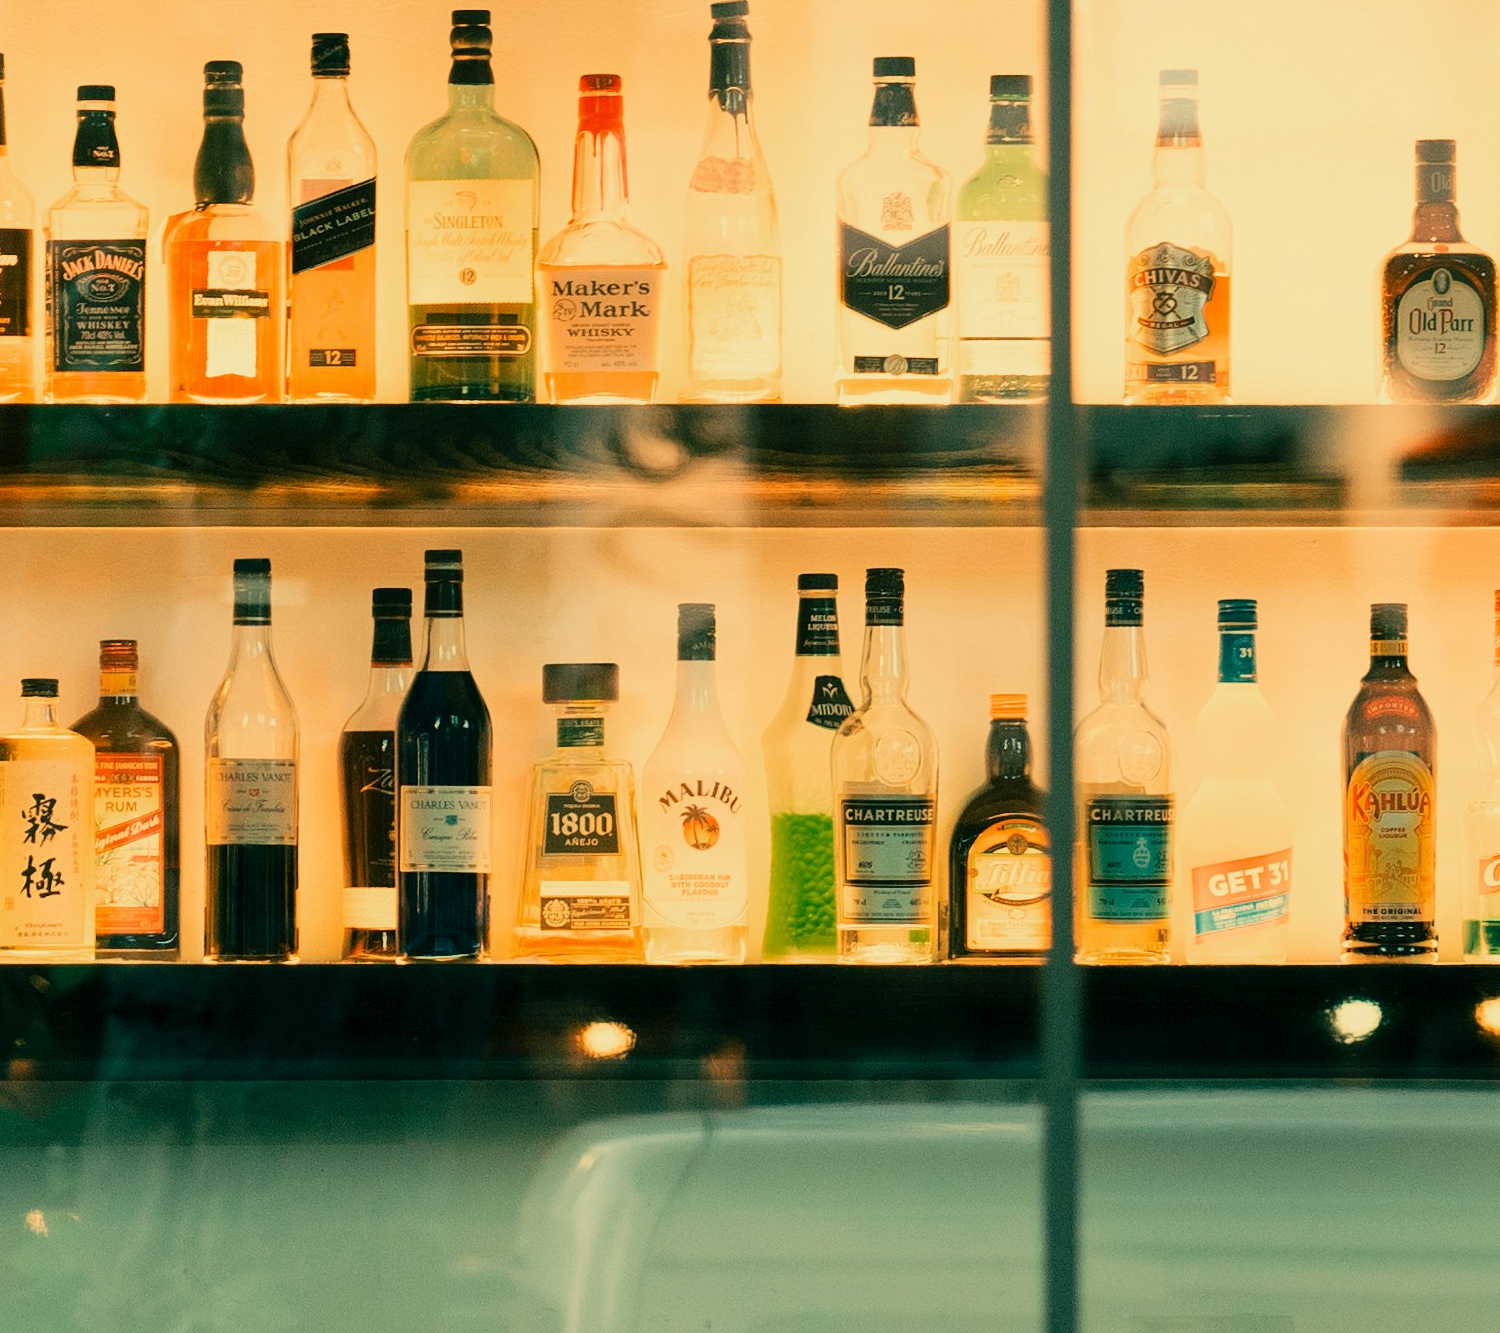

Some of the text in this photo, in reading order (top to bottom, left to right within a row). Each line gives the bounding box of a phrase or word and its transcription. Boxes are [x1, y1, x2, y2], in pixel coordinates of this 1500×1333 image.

[298, 197, 368, 229] JOHNNIE WALKER
[433, 211, 503, 229] SINGLETON
[293, 209, 376, 243] BLACK LABEL
[61, 249, 145, 282] JACK DANIEL'S
[846, 247, 945, 278] Ballantine's
[1134, 269, 1201, 289] CHIVAS
[551, 279, 651, 298] Maker's
[887, 284, 906, 301] 12
[75, 302, 131, 316] Tennessee
[194, 293, 269, 308] Evan Williams
[578, 300, 651, 318] Mark
[1426, 296, 1454, 311] Grand
[76, 319, 131, 331] WHISKEY
[1408, 308, 1475, 335] Old Parr
[566, 327, 636, 338] WHISKY
[1434, 342, 1447, 354] 12
[324, 350, 341, 365] 12
[1180, 364, 1198, 379] 12
[1239, 647, 1253, 659] 31
[811, 701, 853, 718] MIDORI
[214, 772, 261, 784] CHARLES
[658, 779, 743, 814] MALIBU
[1352, 782, 1431, 824] KAHLÚA
[104, 801, 138, 813] RUM
[409, 799, 457, 812] CHARLES
[845, 807, 934, 822] CHARTREUSE
[1090, 807, 1176, 822] CHARTREUSE
[129, 815, 161, 836] Dark
[550, 812, 613, 836] 1800
[564, 836, 600, 848] AÑEJO
[1208, 859, 1290, 898] GET 31
